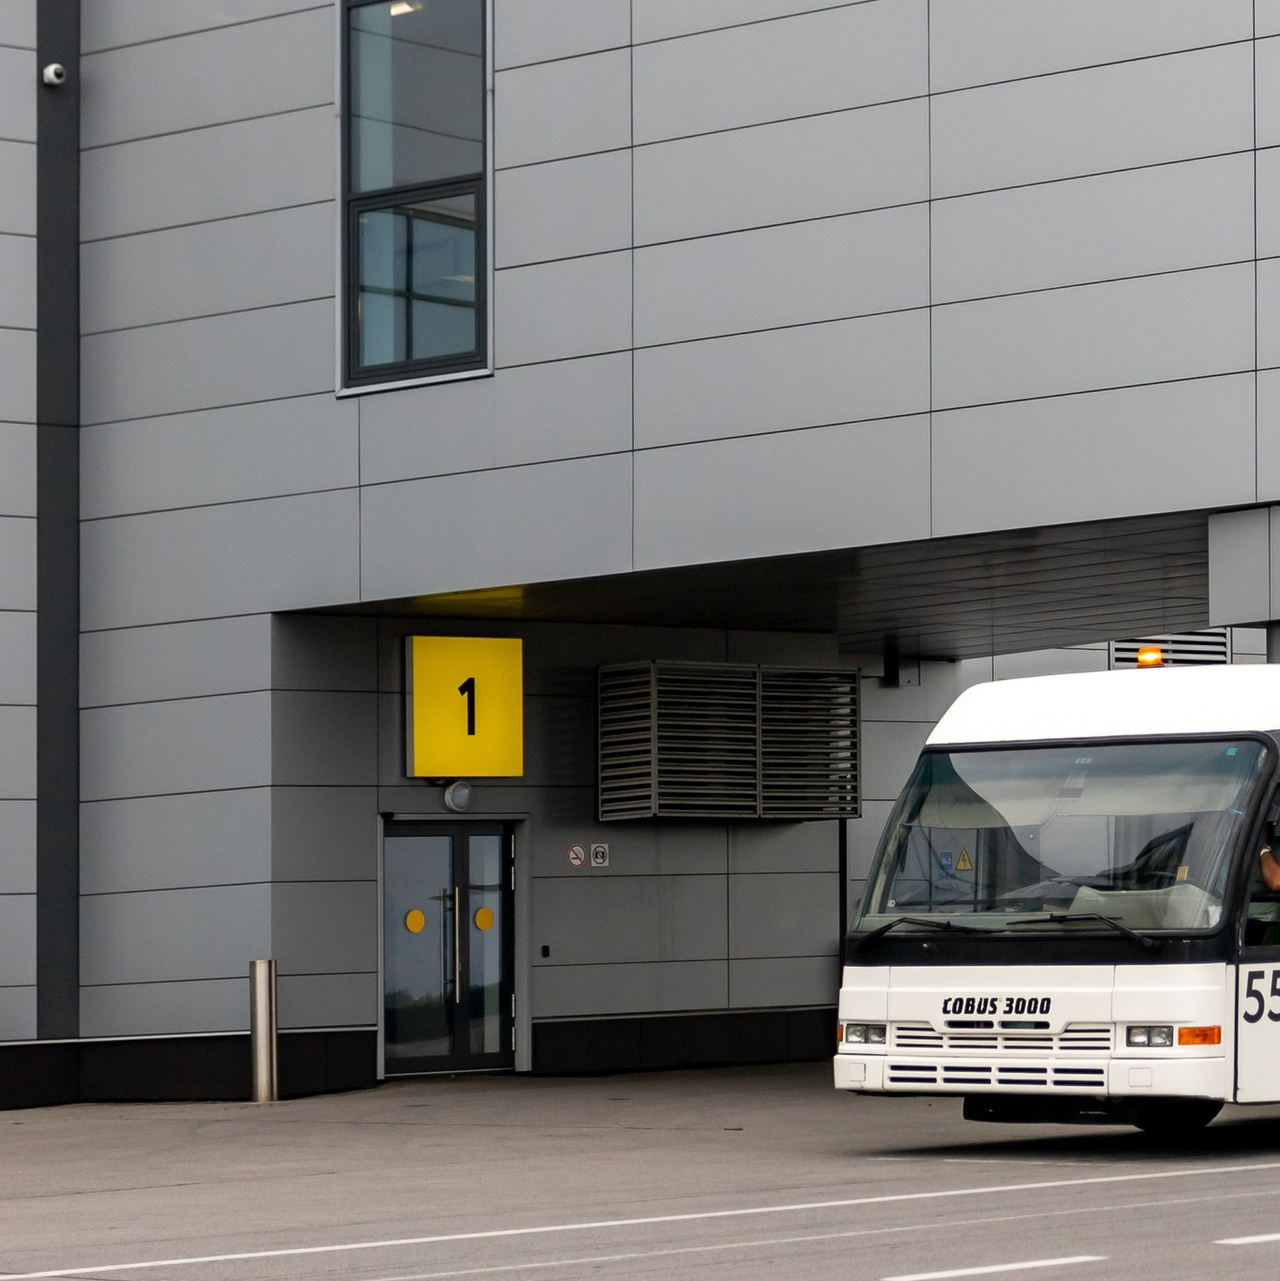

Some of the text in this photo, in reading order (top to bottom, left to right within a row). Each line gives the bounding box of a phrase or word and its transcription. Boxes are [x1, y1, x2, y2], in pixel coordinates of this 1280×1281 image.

[457, 676, 476, 736] 1
[941, 997, 1052, 1015] COBUS 3000
